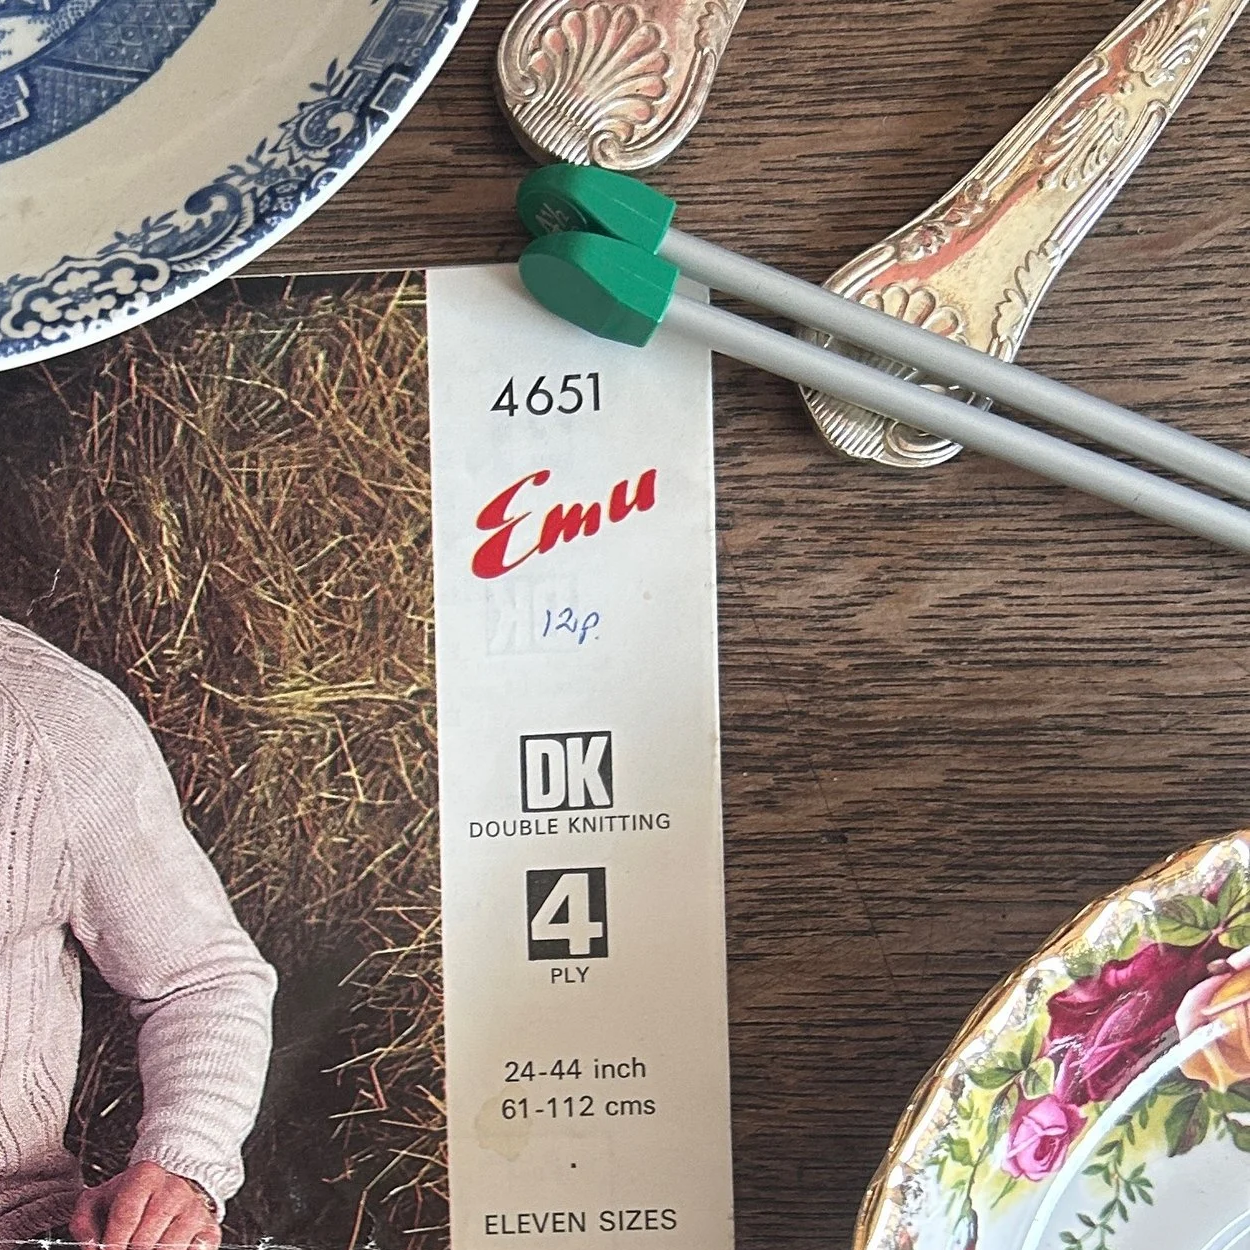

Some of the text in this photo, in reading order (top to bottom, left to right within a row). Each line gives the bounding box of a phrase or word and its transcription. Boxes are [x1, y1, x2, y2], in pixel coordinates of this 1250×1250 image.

[490, 372, 601, 417] 4651
[471, 468, 658, 580] Emu
[525, 736, 611, 809] DK
[469, 813, 671, 839] DOUBLE KNITTING
[531, 872, 604, 956] 4
[550, 966, 590, 985] PLY
[504, 1056, 647, 1083] 24-44 inch
[501, 1095, 656, 1120] 61-112 cms
[485, 1208, 678, 1236] ELEVEN SIZES
